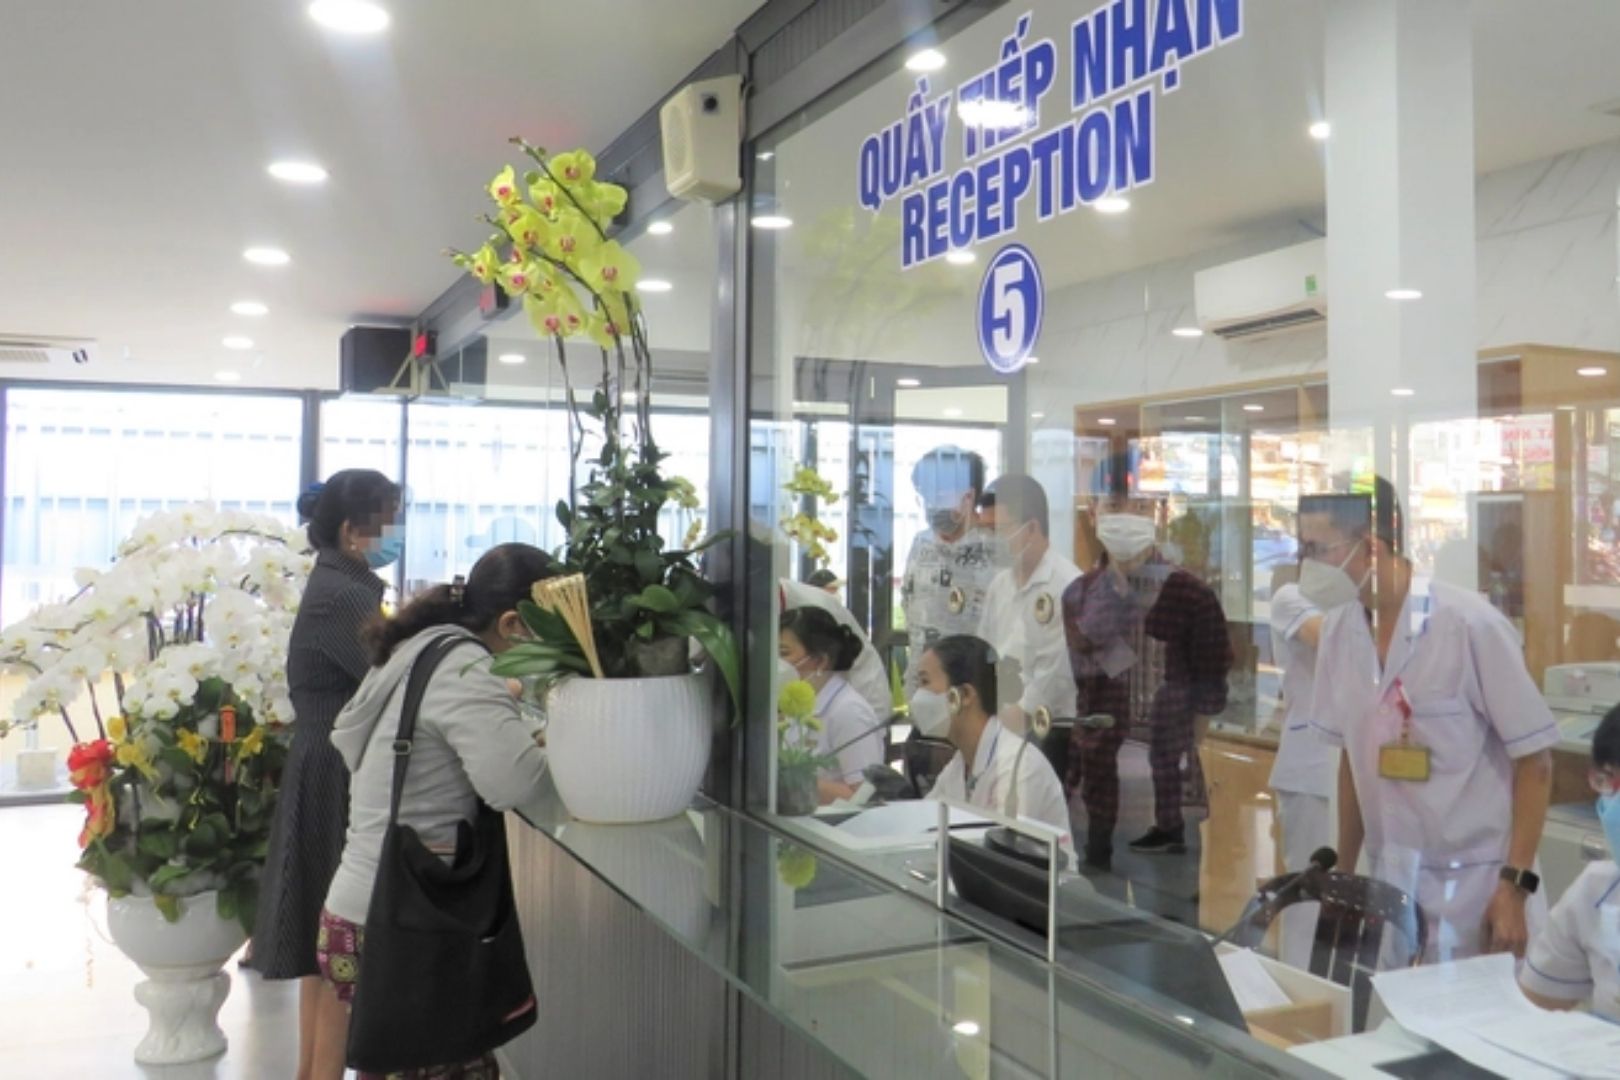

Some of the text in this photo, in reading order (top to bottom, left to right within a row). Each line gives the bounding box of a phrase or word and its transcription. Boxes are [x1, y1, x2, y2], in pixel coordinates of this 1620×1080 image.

[859, 76, 953, 213] QUẦY
[958, 11, 1056, 160] TIẾP
[903, 86, 1153, 268] RECEPTION
[992, 260, 1026, 358] 5
